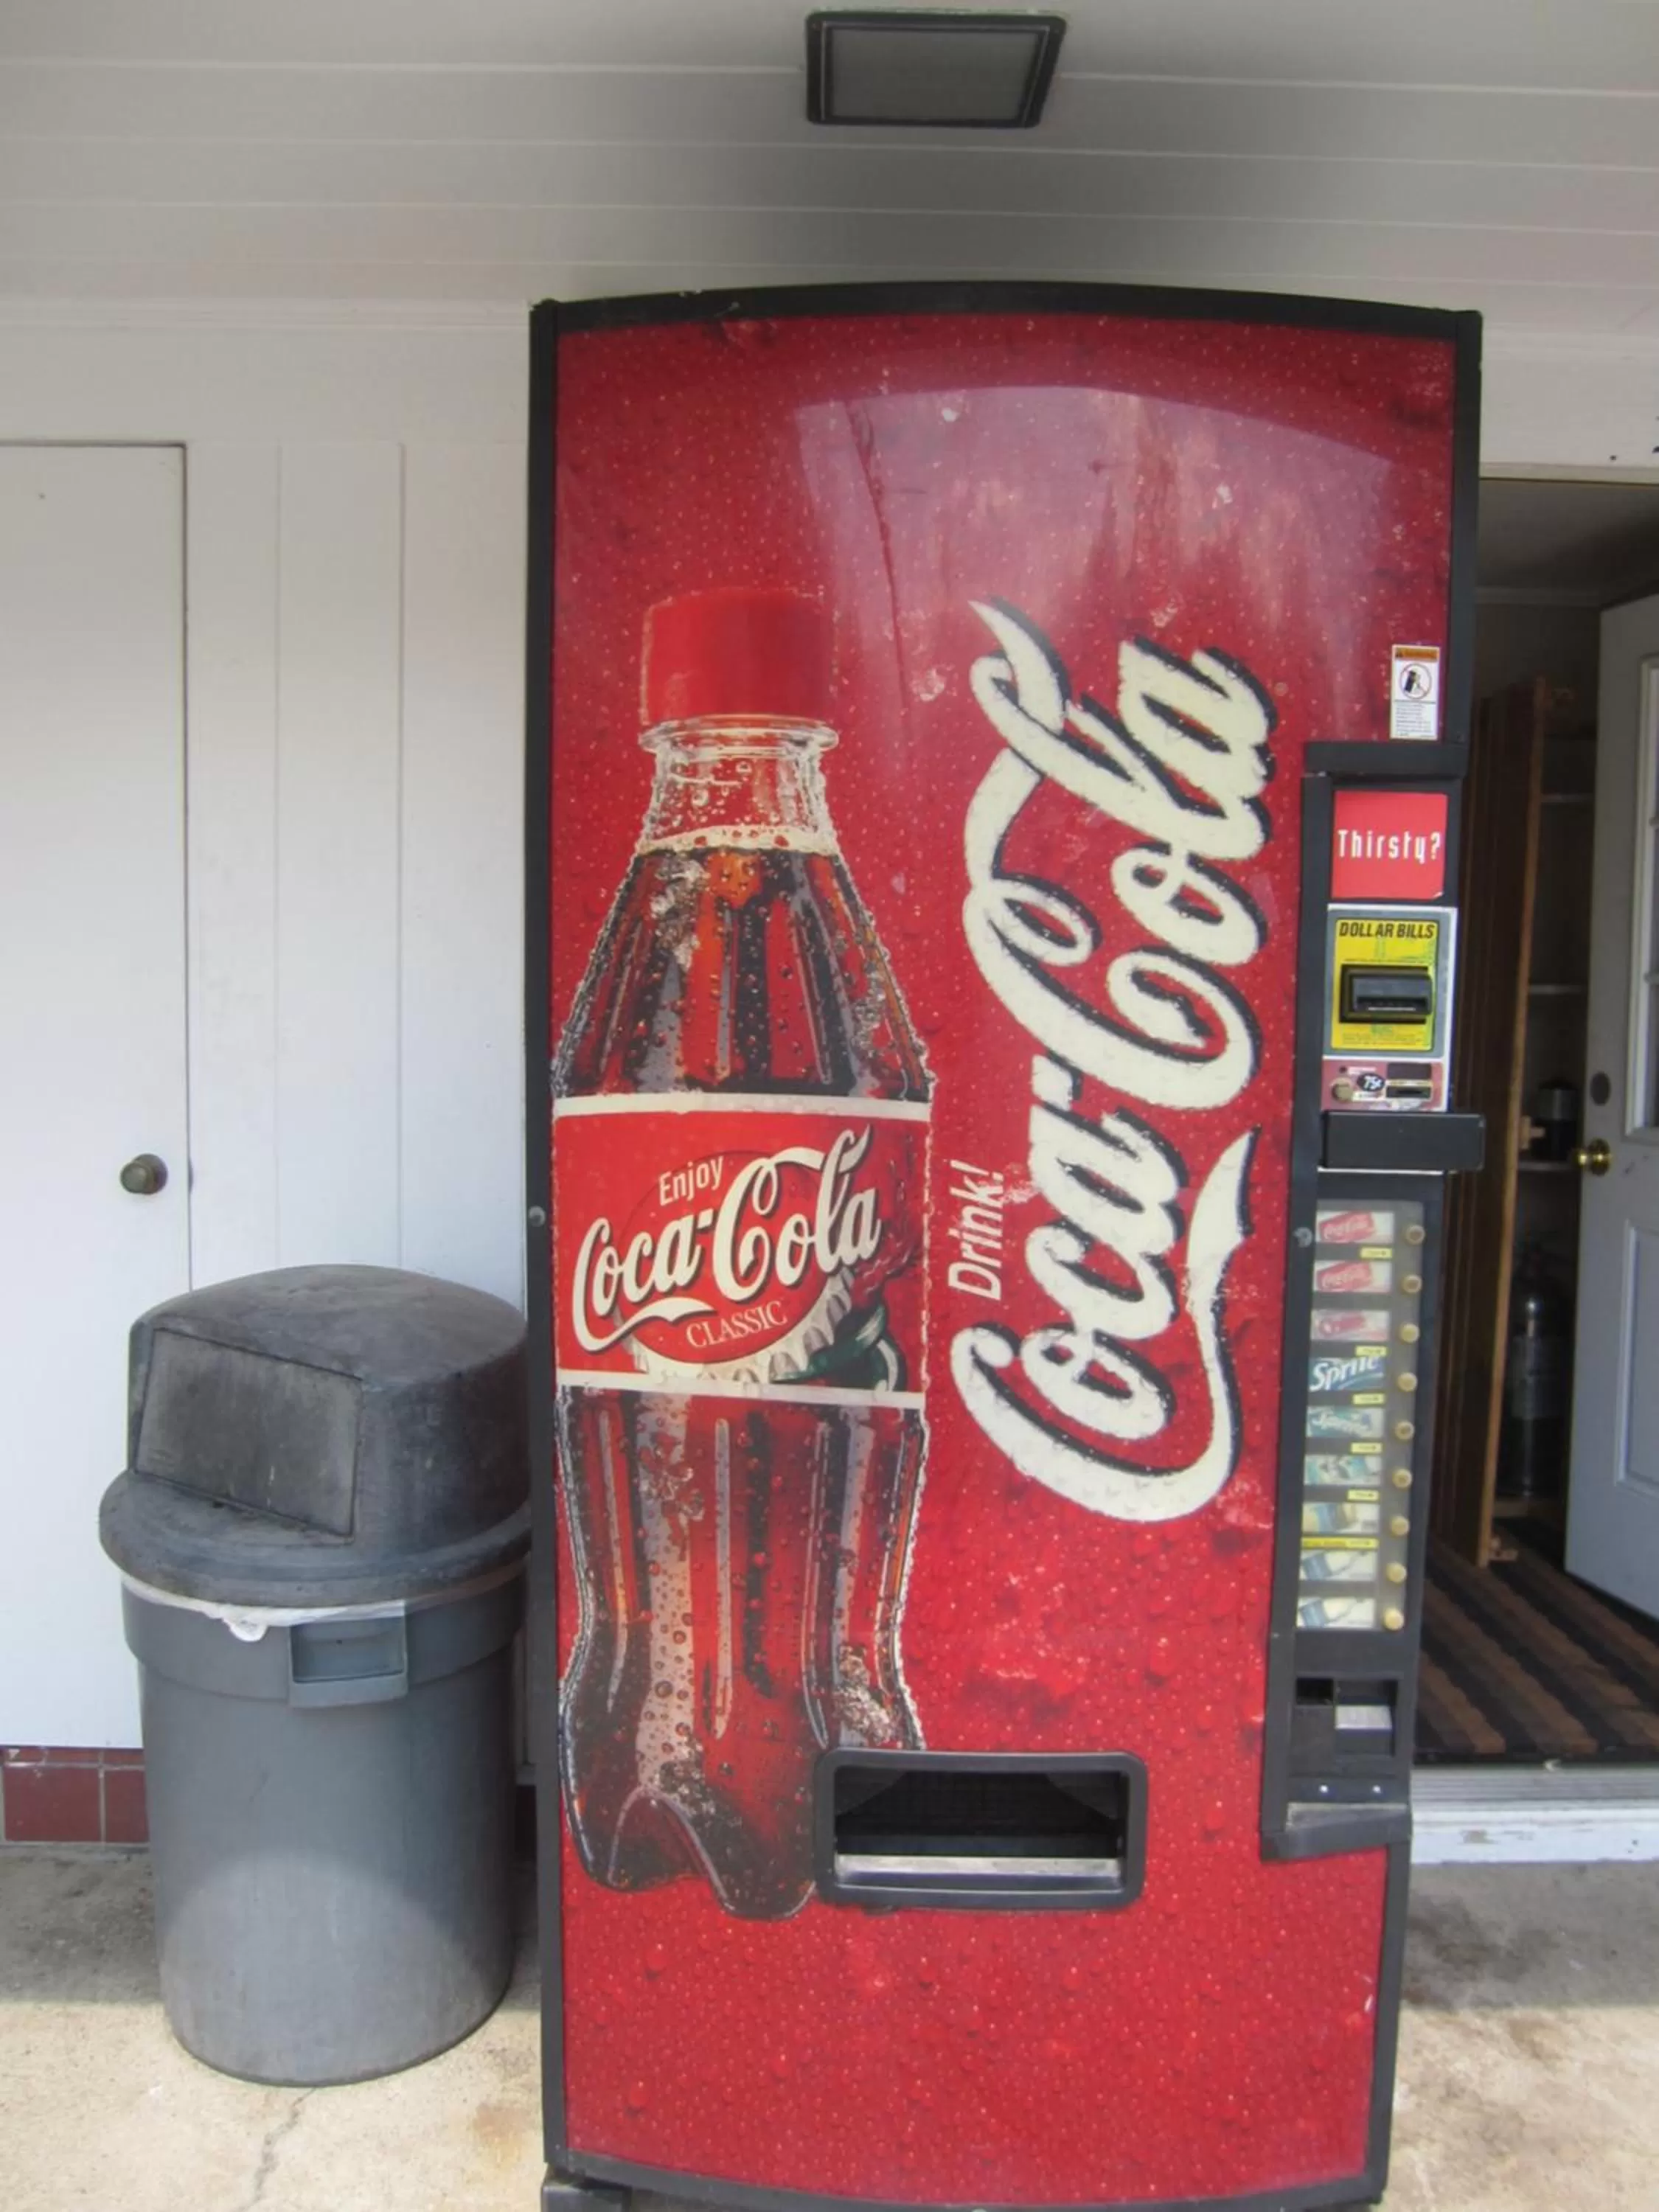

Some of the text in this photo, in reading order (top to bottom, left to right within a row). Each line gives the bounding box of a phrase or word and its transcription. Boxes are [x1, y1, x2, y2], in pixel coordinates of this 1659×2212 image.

[1337, 829, 1441, 864] Thirsty?
[1338, 922, 1435, 939] DOLLAR BILLS
[949, 599, 1274, 1523] Coca-Cola
[658, 1155, 724, 1206] Enjoy
[571, 1124, 883, 1352] Coca-Cola
[947, 1159, 1004, 1301] Drink!
[686, 1300, 788, 1349] CLASSIC
